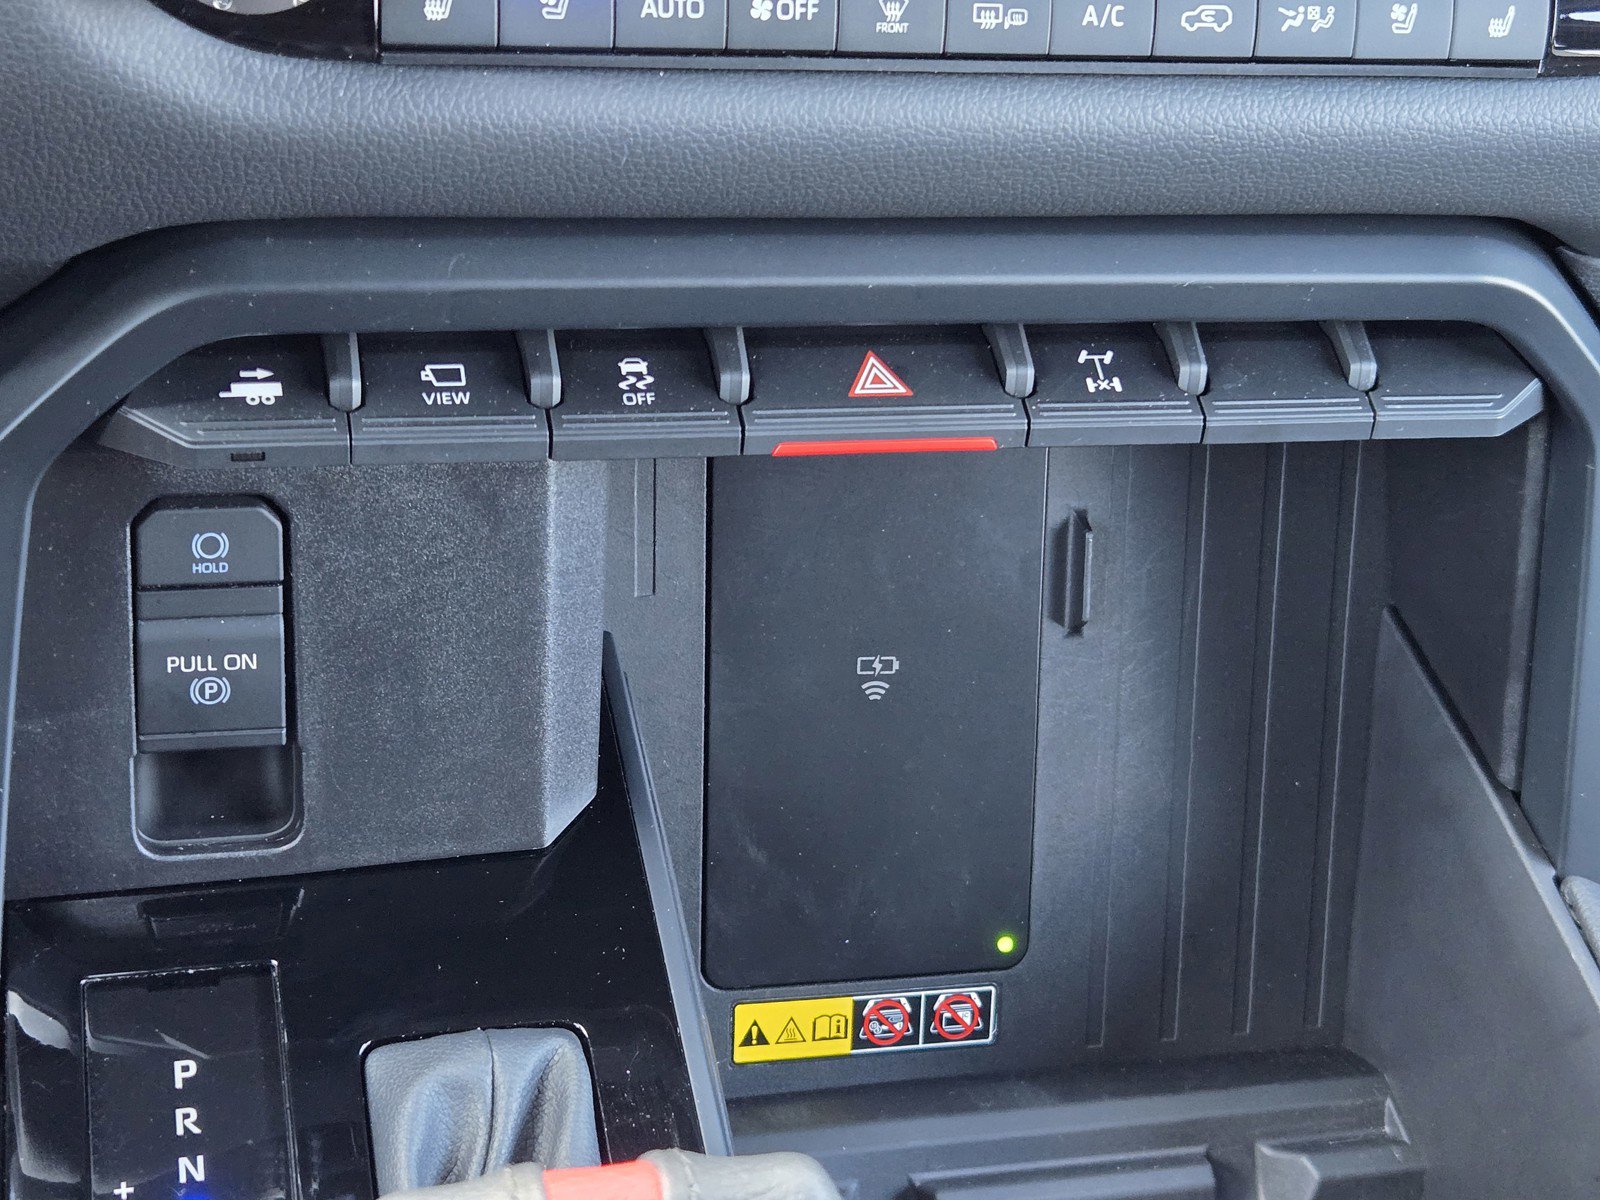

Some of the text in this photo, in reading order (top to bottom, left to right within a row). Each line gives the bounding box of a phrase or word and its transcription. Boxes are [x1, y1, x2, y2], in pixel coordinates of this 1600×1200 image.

[640, 0, 706, 20] AUTO
[776, 0, 820, 21] OFF
[1081, 4, 1126, 28] A/C
[875, 22, 909, 34] FRONT
[421, 391, 471, 406] VIEW
[621, 391, 656, 406] OFF
[192, 561, 229, 574] HOLD
[166, 653, 258, 674] PULL ON
[204, 682, 218, 700] P
[173, 1059, 198, 1090] P
[175, 1107, 202, 1136] R
[178, 1154, 205, 1184] N
